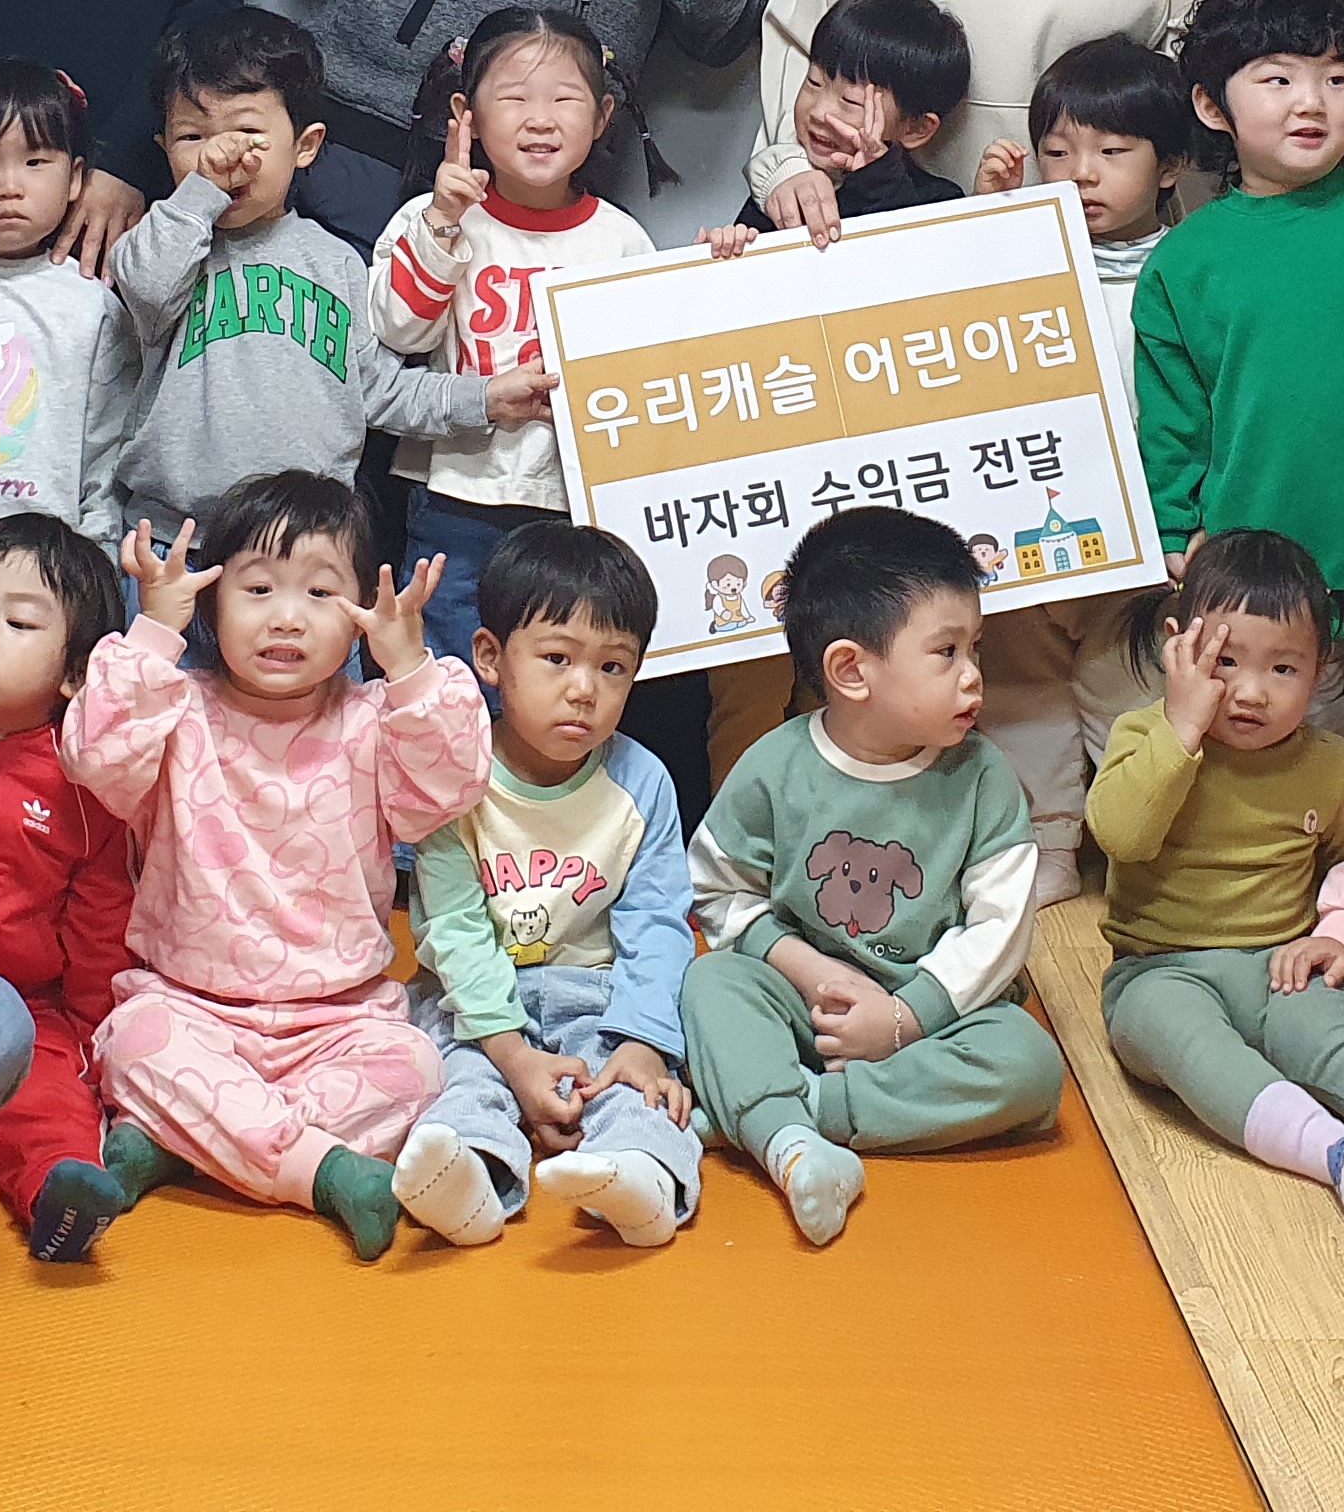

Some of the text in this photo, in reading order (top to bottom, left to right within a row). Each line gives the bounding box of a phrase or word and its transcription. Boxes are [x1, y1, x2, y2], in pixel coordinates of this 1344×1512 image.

[178, 263, 351, 384] EARTH
[583, 354, 818, 448] 우리캐슬
[844, 306, 1077, 395] 어린이집
[643, 430, 1065, 548] 바자회 수익금 전달
